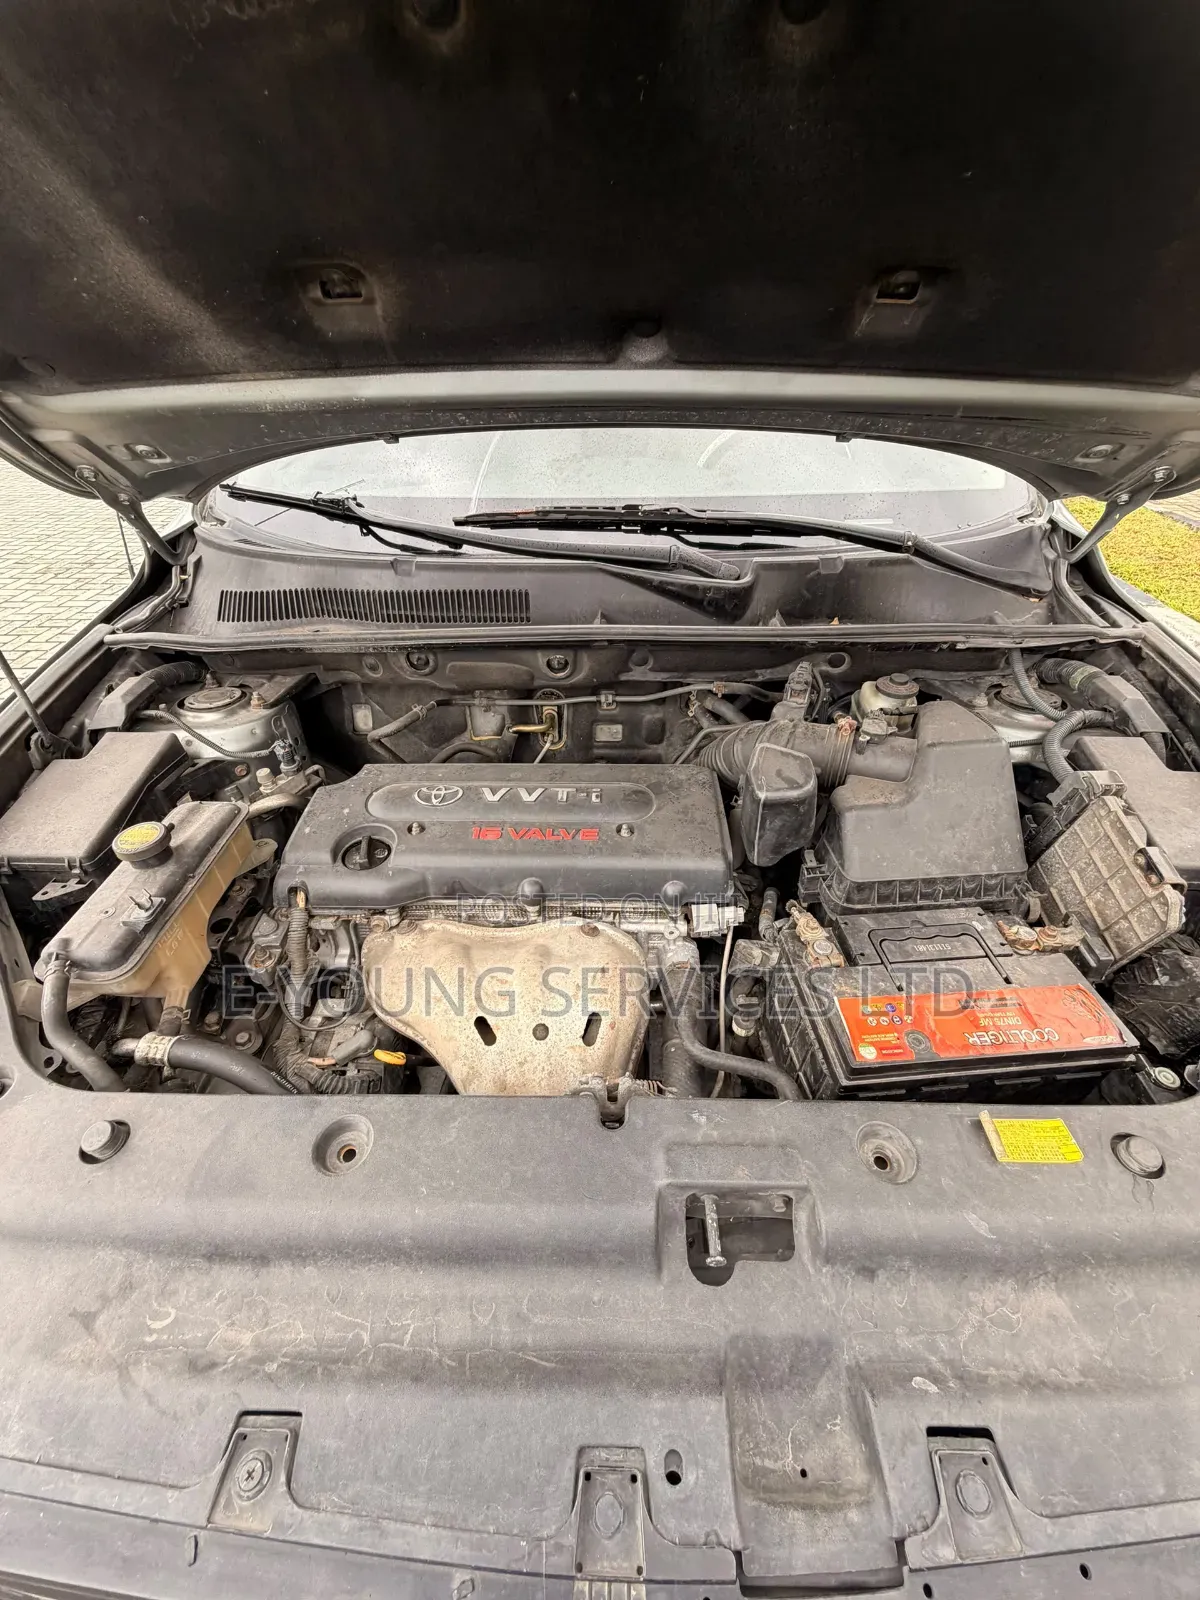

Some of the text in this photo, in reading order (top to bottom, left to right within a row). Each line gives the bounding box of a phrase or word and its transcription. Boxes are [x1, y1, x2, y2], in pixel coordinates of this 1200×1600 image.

[480, 787, 603, 804] VVT-i
[471, 826, 600, 842] 16 VALVE
[994, 1016, 1022, 1026] DIN75
[963, 1027, 1060, 1047] COOLTIGER
